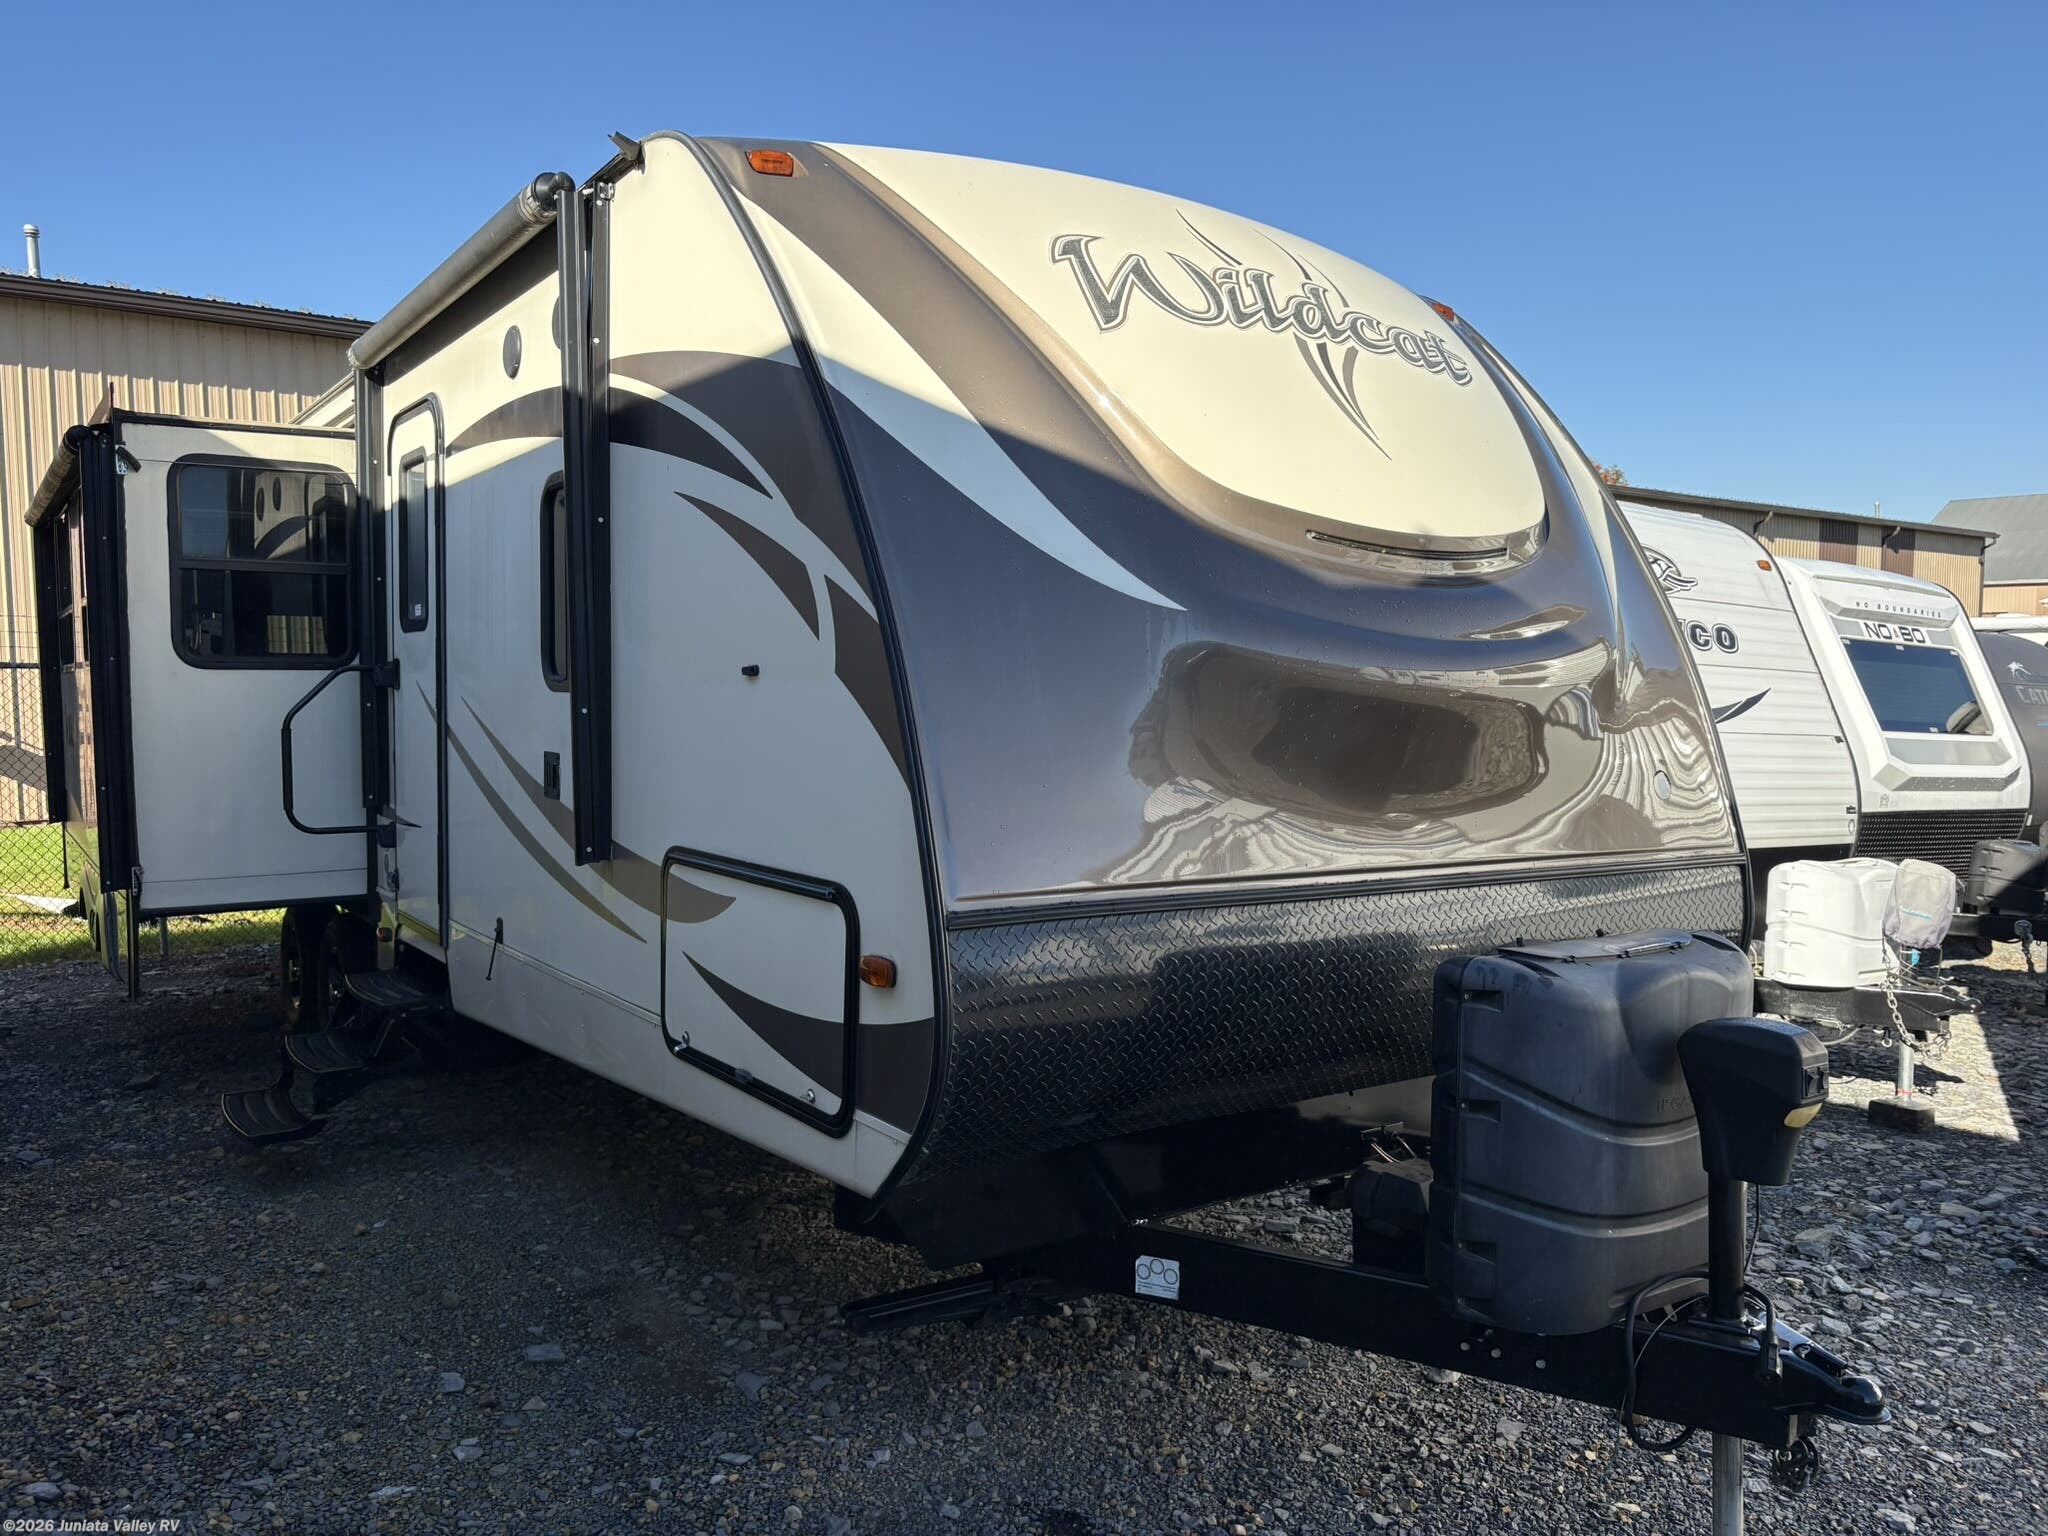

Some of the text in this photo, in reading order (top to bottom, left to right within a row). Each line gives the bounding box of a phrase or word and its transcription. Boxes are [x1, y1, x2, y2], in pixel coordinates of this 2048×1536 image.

[1050, 233, 1473, 386] Wildcat
[1855, 601, 1942, 619] NO BOUNDARIES
[1677, 617, 1739, 654] CO
[1863, 621, 1927, 644] NO BO
